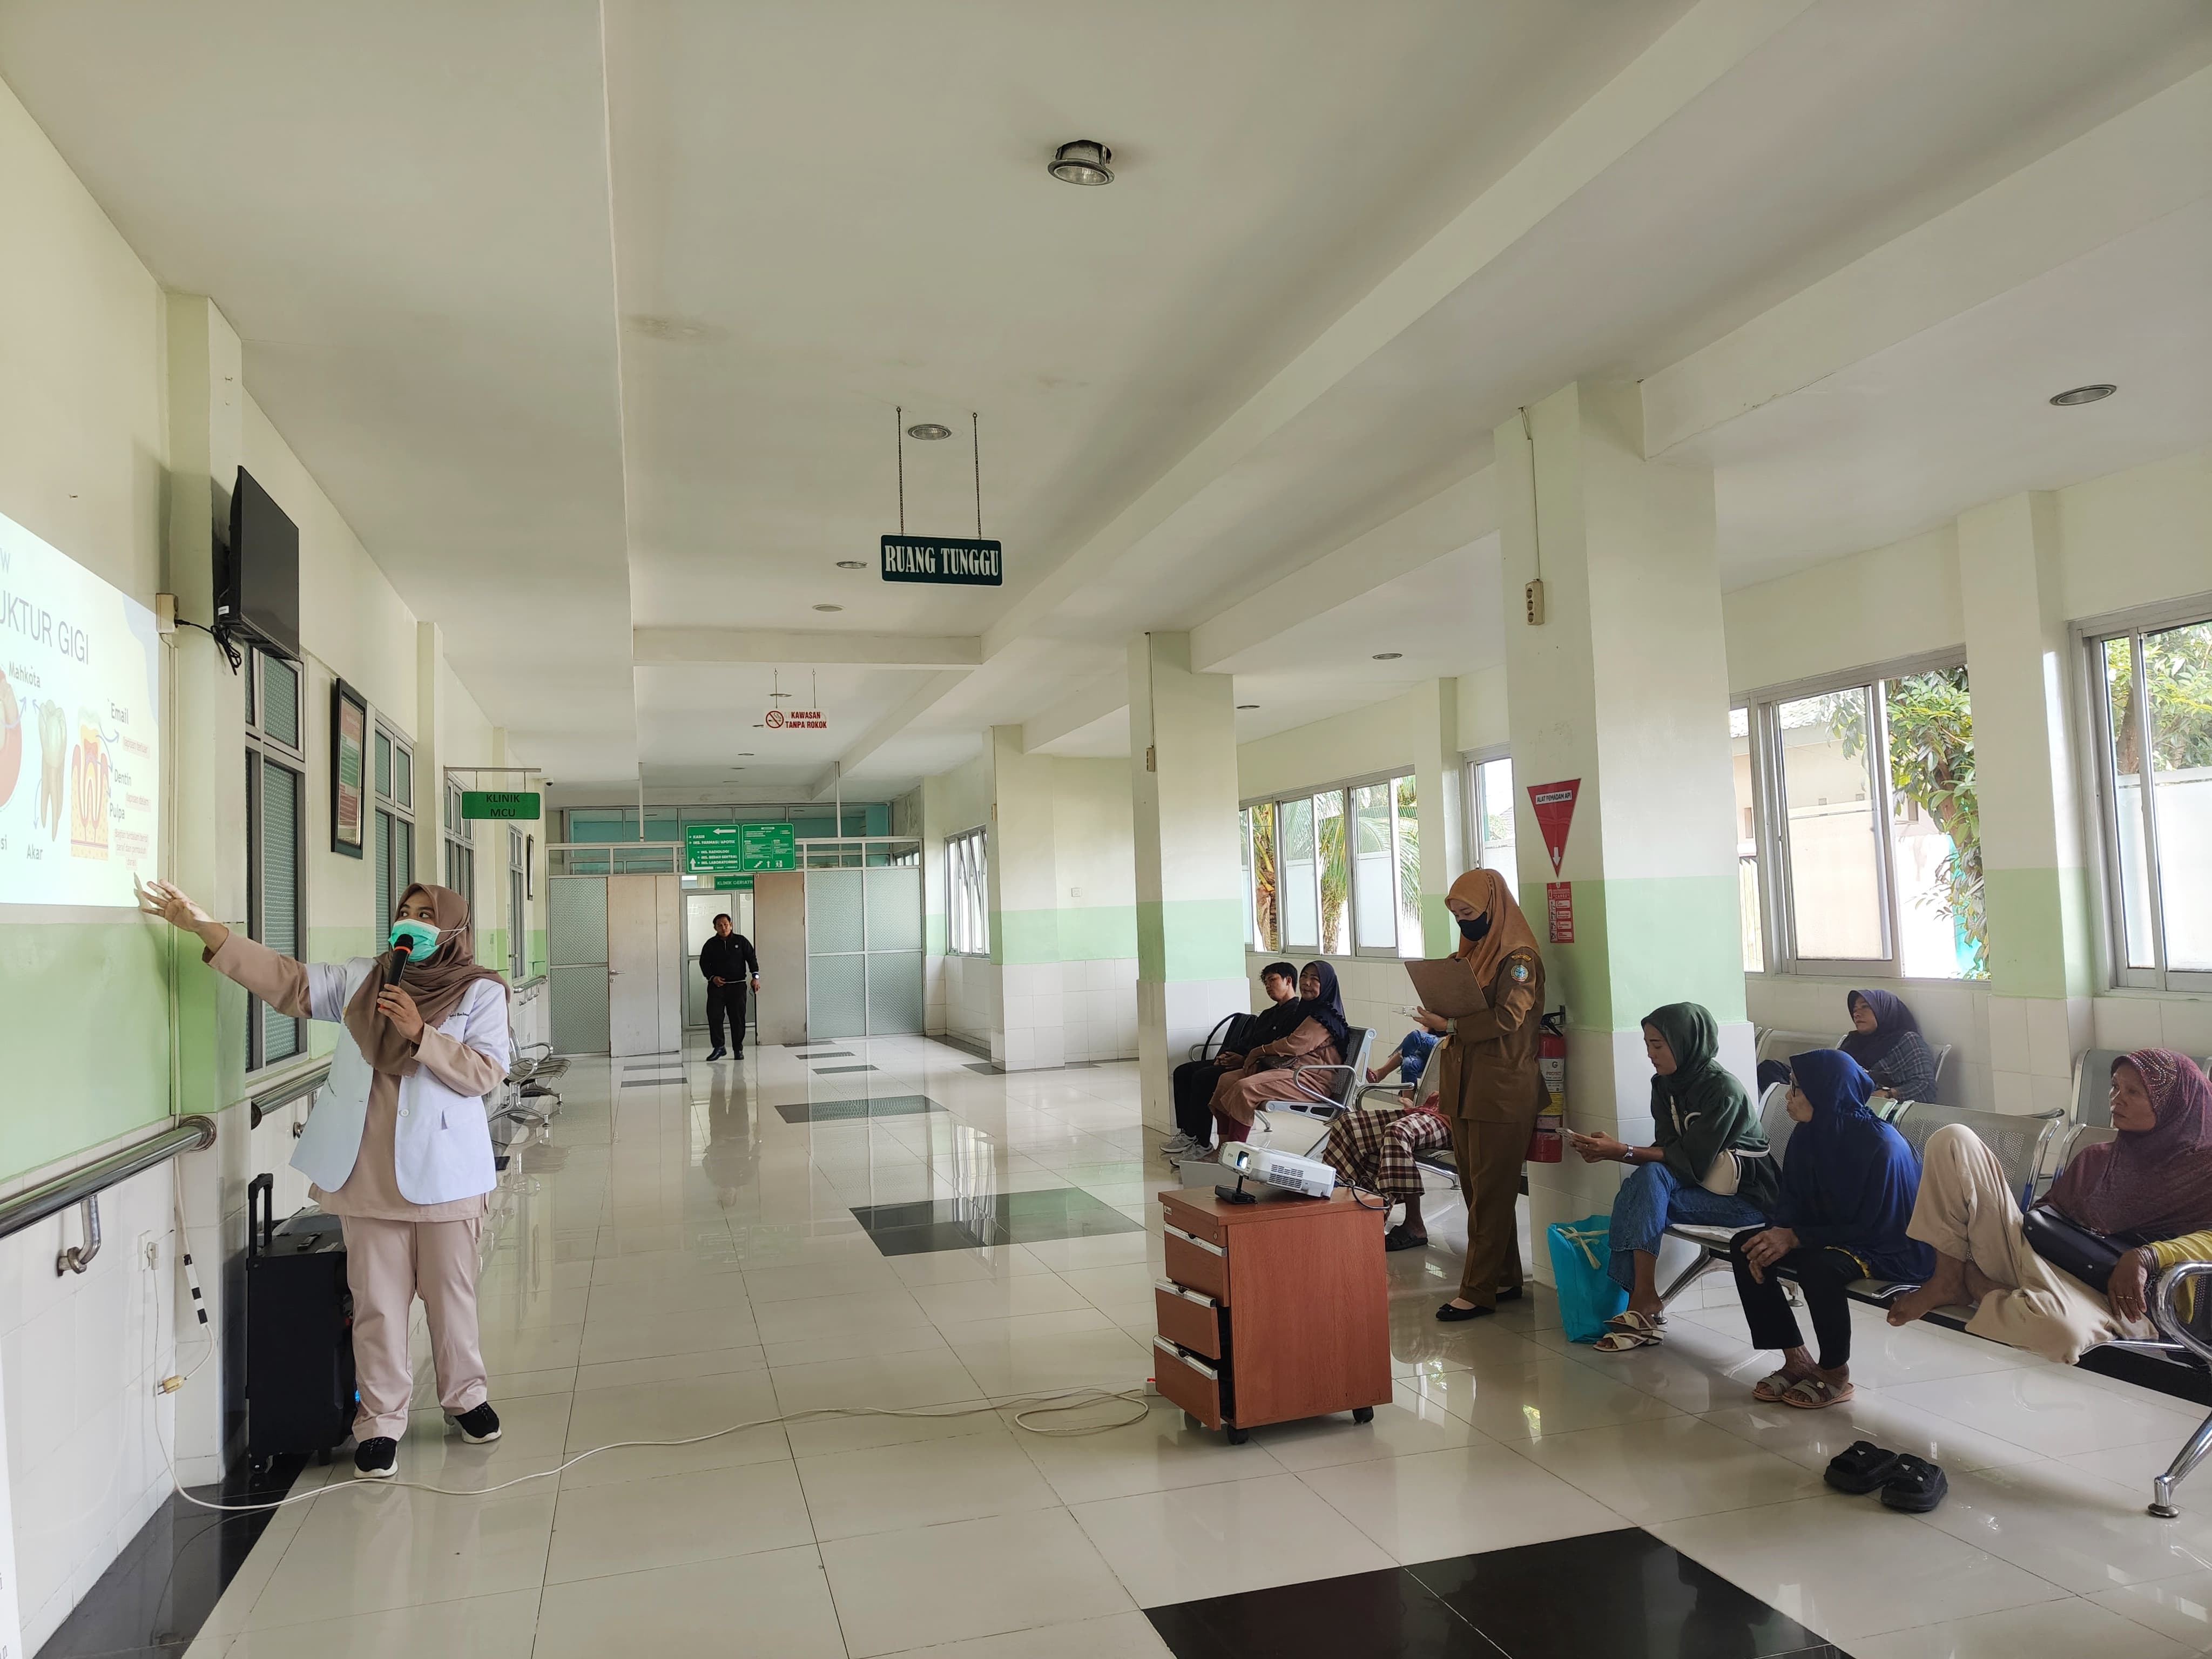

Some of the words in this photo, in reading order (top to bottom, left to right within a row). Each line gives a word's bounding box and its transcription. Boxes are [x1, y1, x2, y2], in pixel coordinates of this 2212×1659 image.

[885, 545, 936, 574] RUANG
[941, 548, 999, 577] TUNGGU
[58, 621, 89, 665] GIGI
[9, 660, 41, 689] Mahkota
[111, 702, 129, 725] Email
[114, 769, 132, 786] Dentin
[486, 794, 520, 802] KLINIK
[1547, 793, 1564, 801] PEMADAM
[110, 802, 125, 822] Pulpa
[490, 808, 515, 817] MCU
[26, 843, 43, 860] Akar
